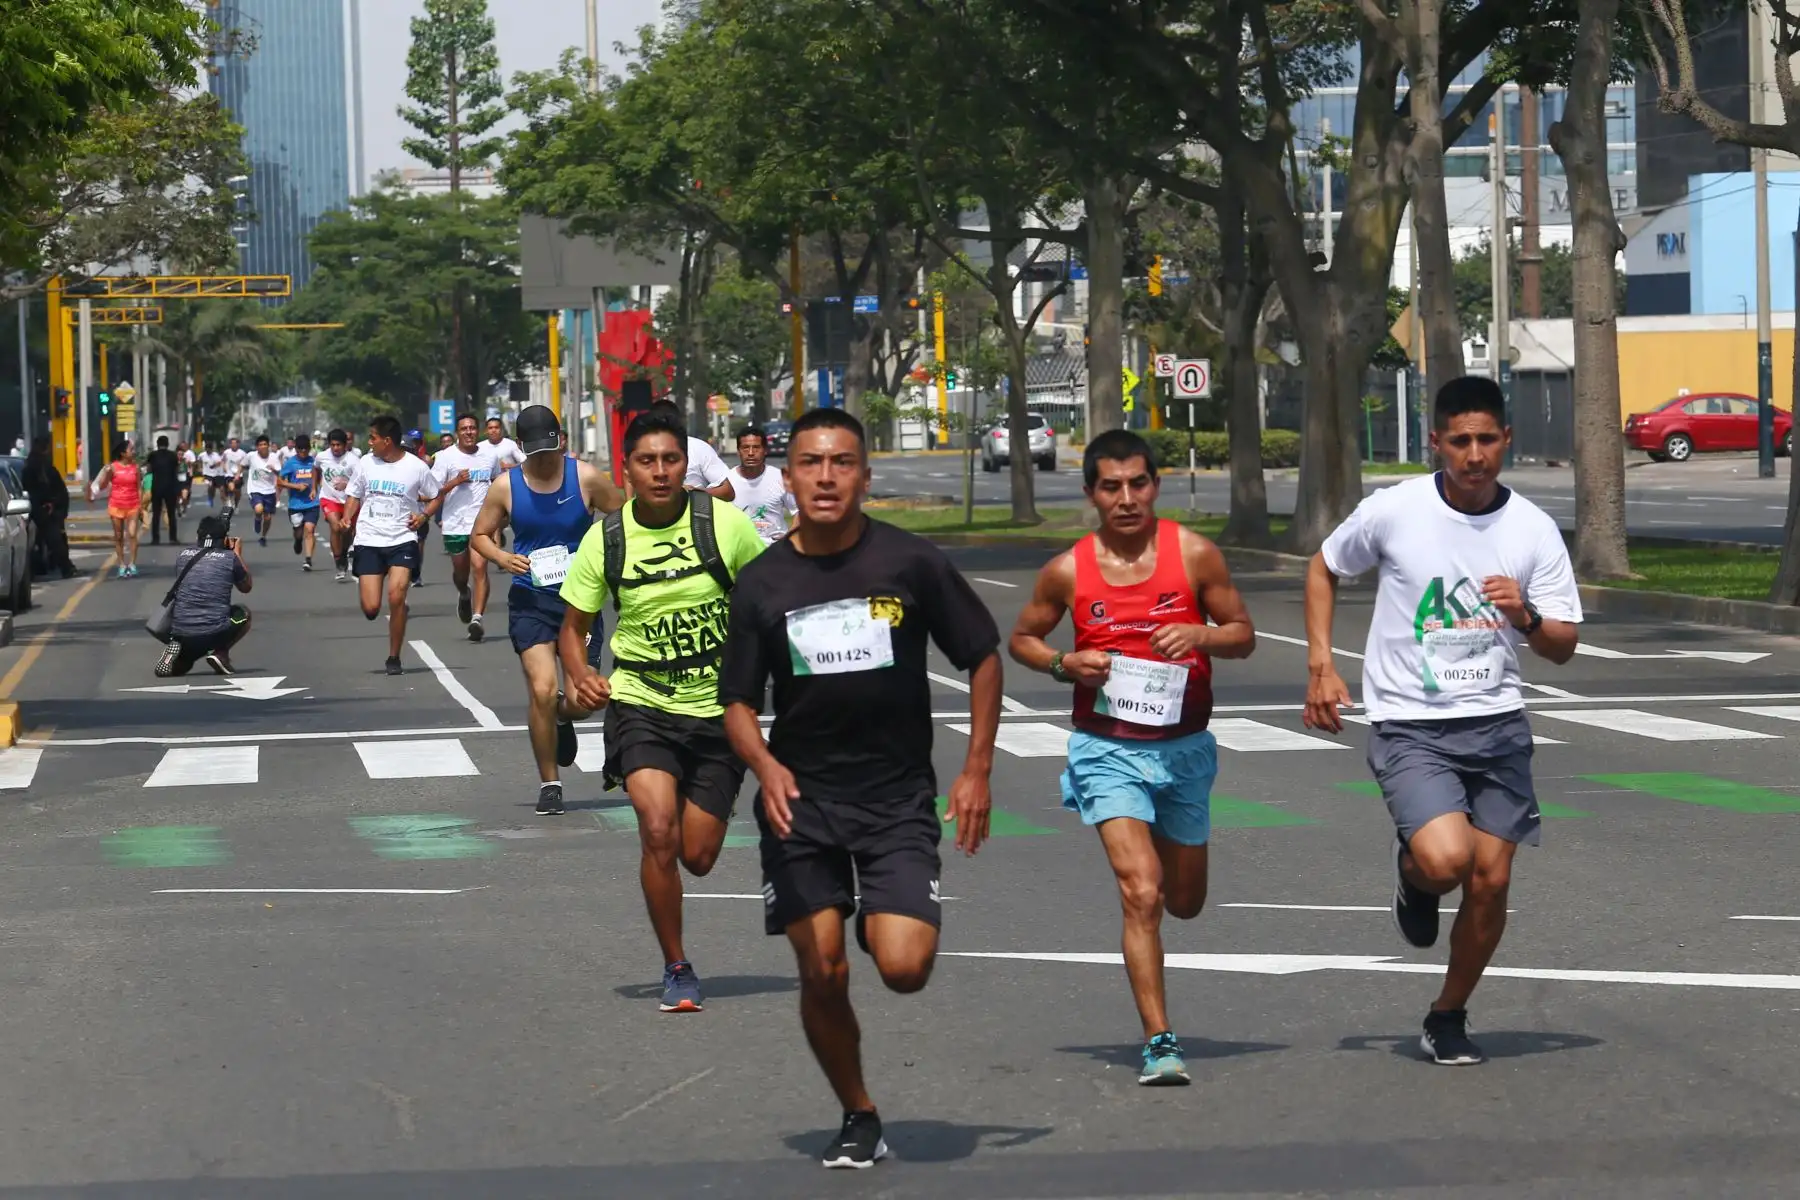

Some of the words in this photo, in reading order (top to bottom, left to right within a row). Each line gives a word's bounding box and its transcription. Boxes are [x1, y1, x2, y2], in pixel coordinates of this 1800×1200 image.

[439, 405, 453, 425] E
[816, 647, 872, 664] 001428
[1444, 668, 1490, 681] 002567
[1118, 697, 1164, 716] 001582
